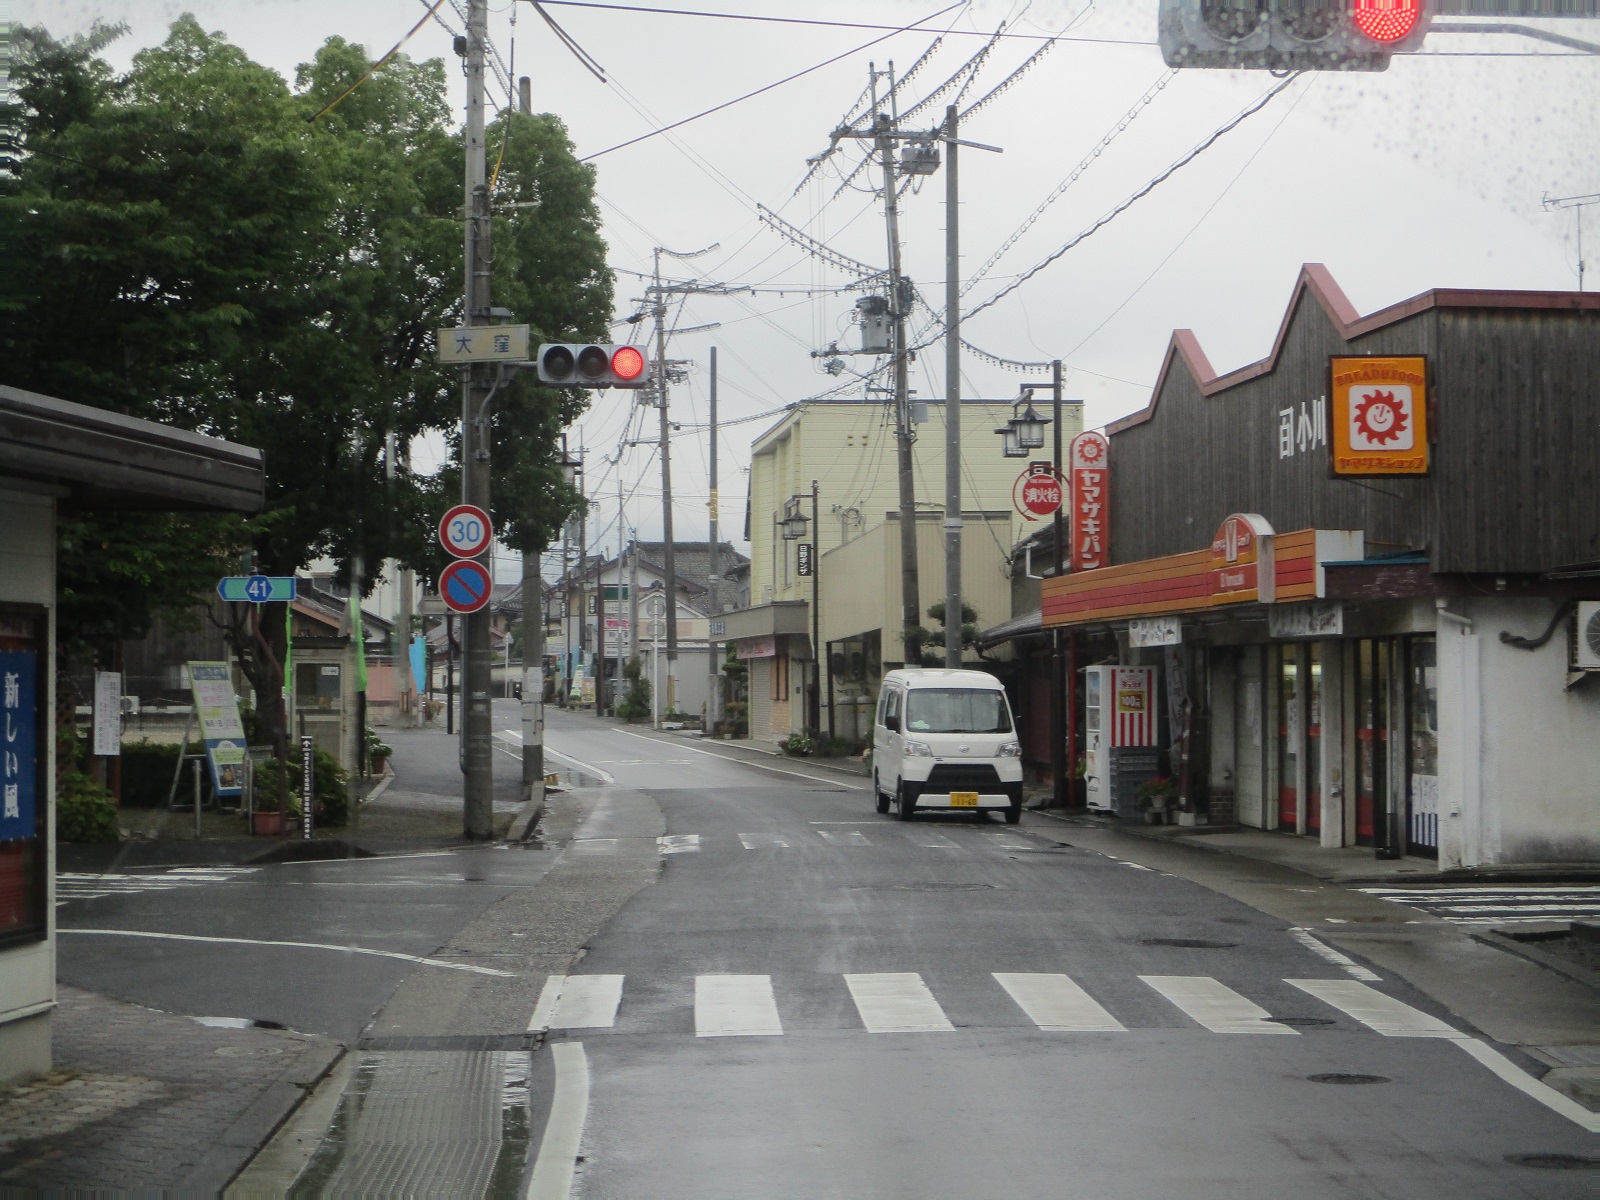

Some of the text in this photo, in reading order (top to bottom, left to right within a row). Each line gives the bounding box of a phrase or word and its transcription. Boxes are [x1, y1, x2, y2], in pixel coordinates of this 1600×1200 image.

[456, 334, 510, 354] 大窪
[1025, 487, 1059, 503] 消火栓
[1081, 470, 1102, 569] ヤマザキパン
[451, 520, 480, 543] 30
[249, 580, 266, 597] 41
